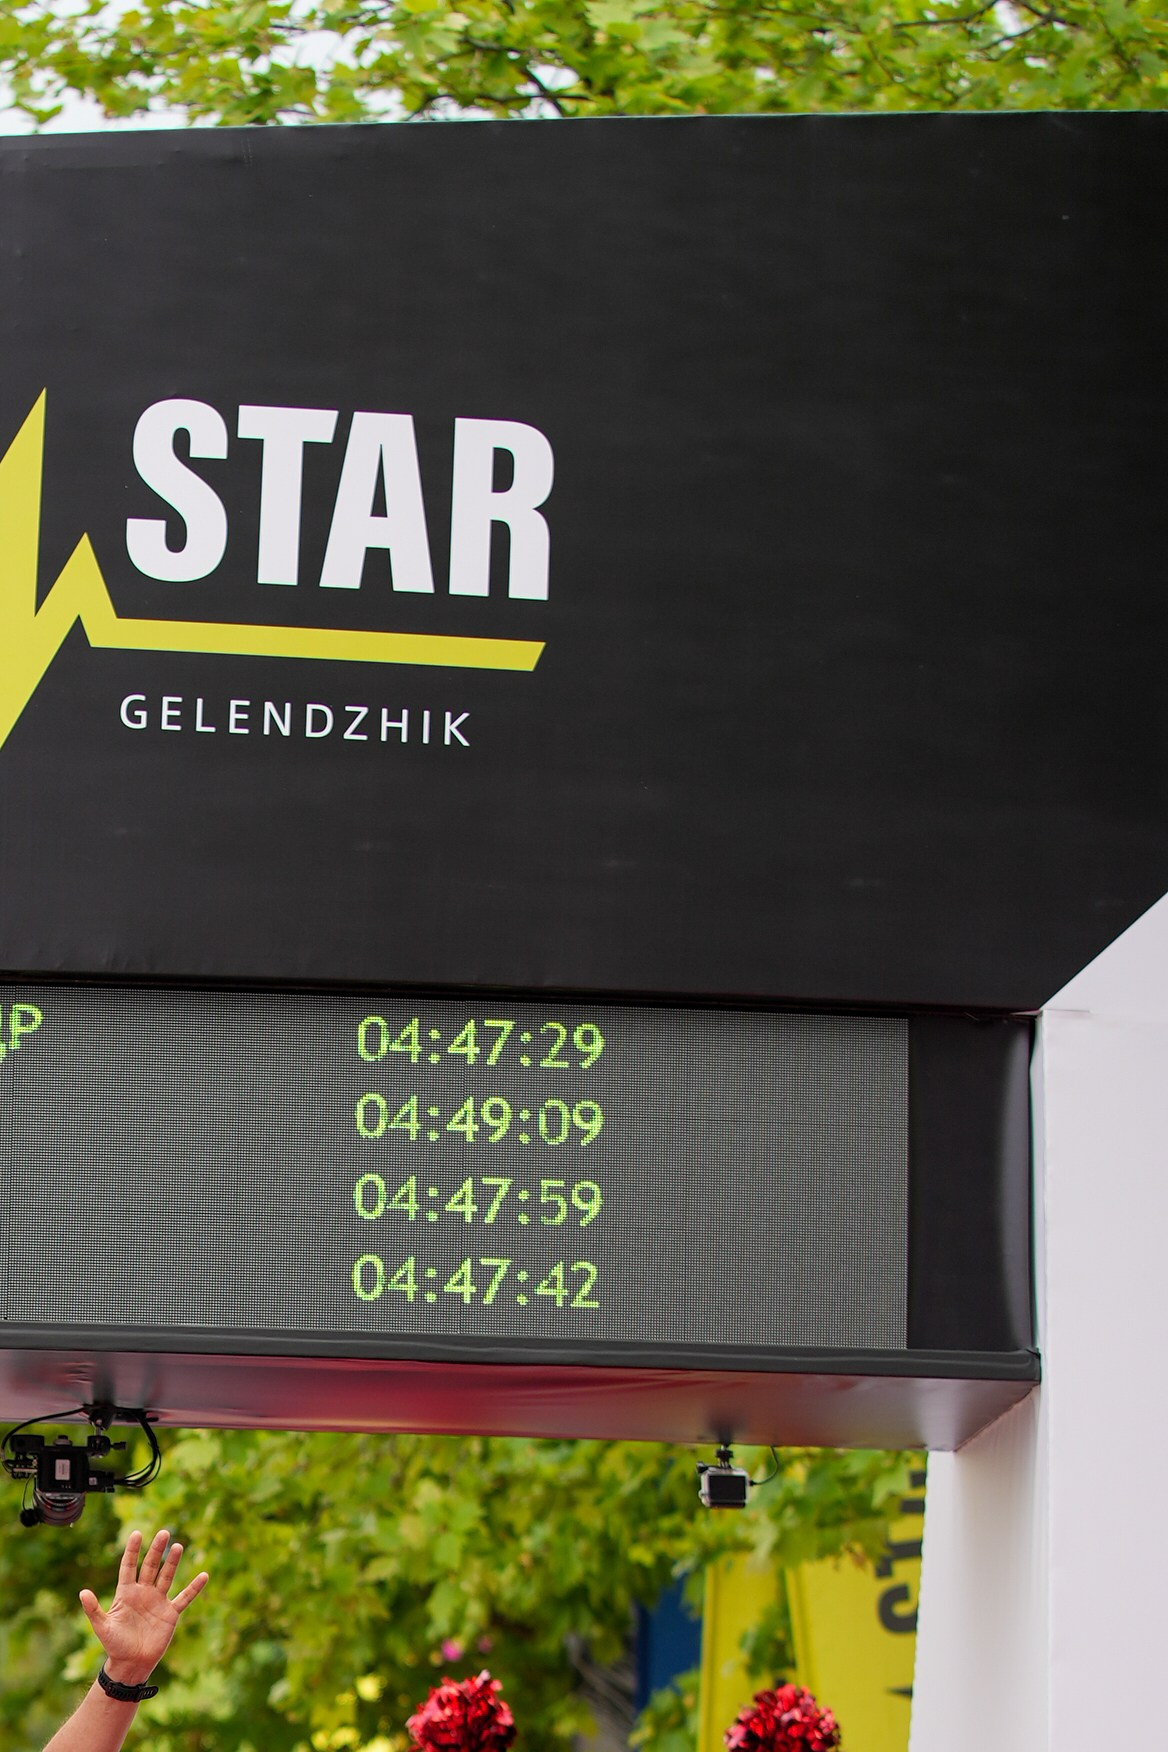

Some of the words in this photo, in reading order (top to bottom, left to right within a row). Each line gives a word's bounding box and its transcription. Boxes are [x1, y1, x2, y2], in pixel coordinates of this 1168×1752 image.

[126, 398, 555, 601] STAR
[120, 694, 472, 747] GELENDZHIK
[357, 1015, 605, 1068] 04:47:29
[355, 1092, 605, 1146] 04:49:09
[353, 1173, 603, 1227] 04:47:59
[351, 1253, 600, 1308] 04:47:42
